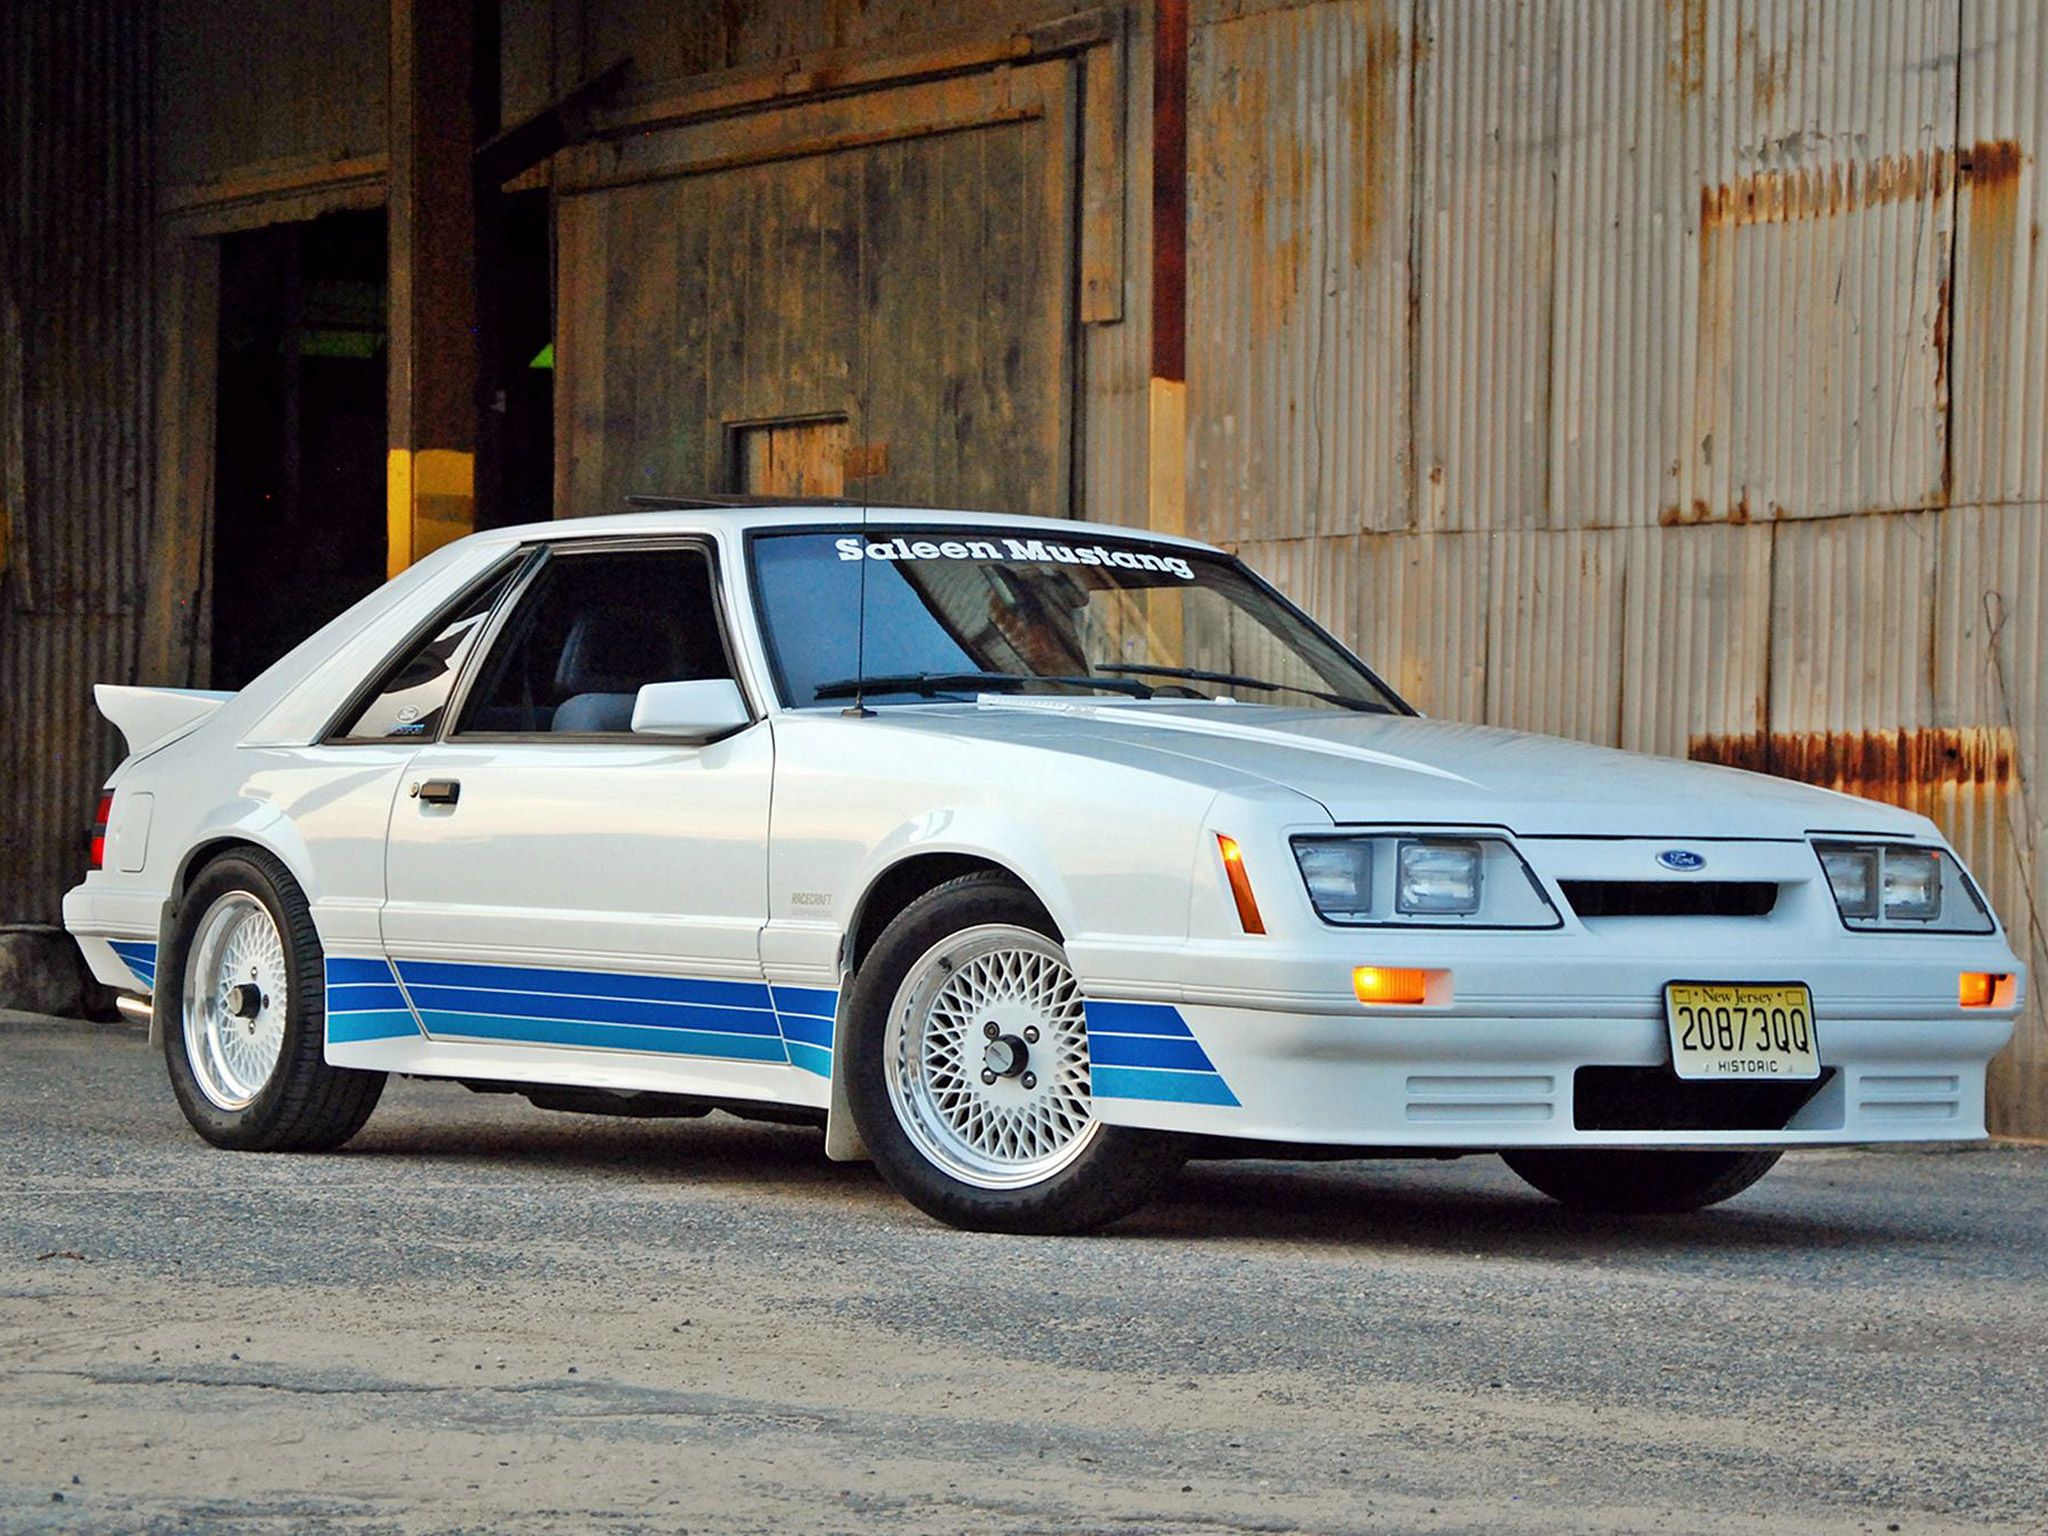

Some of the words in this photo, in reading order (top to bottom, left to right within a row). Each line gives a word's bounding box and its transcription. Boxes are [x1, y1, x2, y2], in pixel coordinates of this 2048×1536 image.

[835, 538, 1001, 561] Saleen
[1001, 539, 1195, 580] Mustang
[1669, 853, 1695, 866] Ford
[1702, 988, 1732, 1003] New
[1734, 988, 1773, 1006] Jersey
[1678, 1006, 1809, 1054] 20873QQ
[1718, 1060, 1778, 1073] HISTORIC
